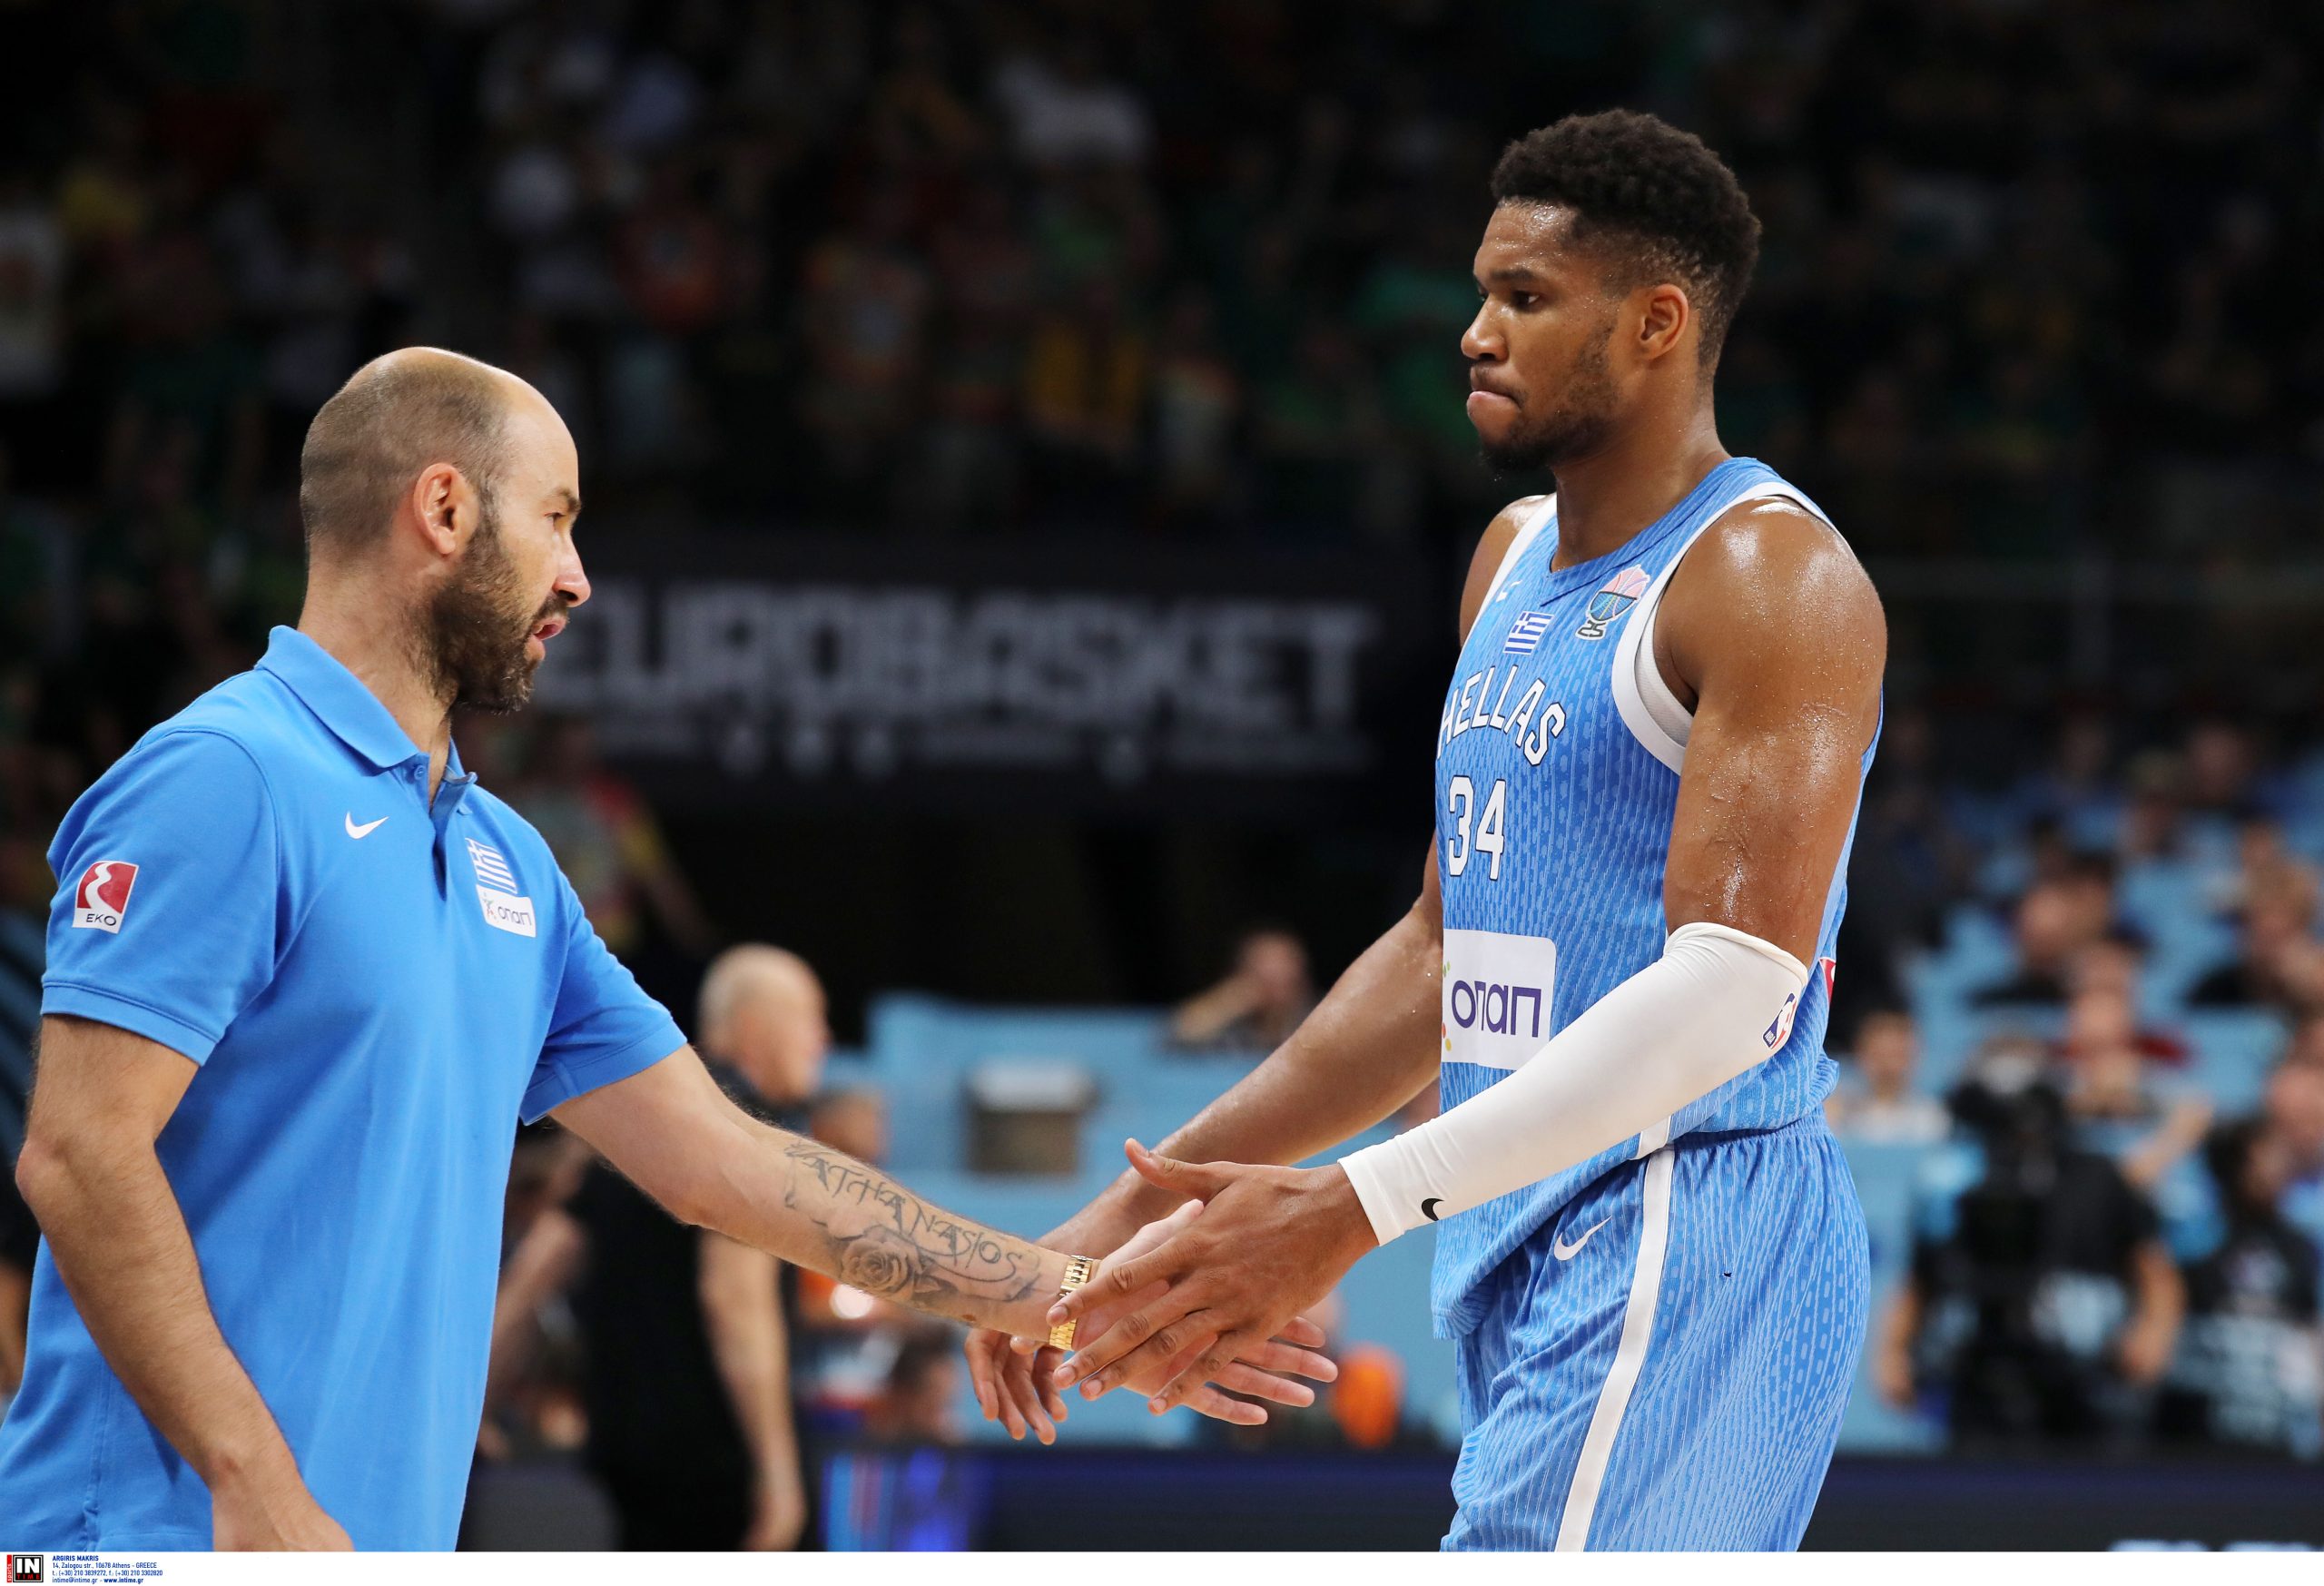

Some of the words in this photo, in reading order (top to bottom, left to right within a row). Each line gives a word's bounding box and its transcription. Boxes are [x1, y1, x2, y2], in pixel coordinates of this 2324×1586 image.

[1437, 664, 1567, 766] HELLAS
[1448, 775, 1507, 882] 34
[85, 913, 117, 926] EKO
[801, 1157, 1023, 1282] ATHANASIOS
